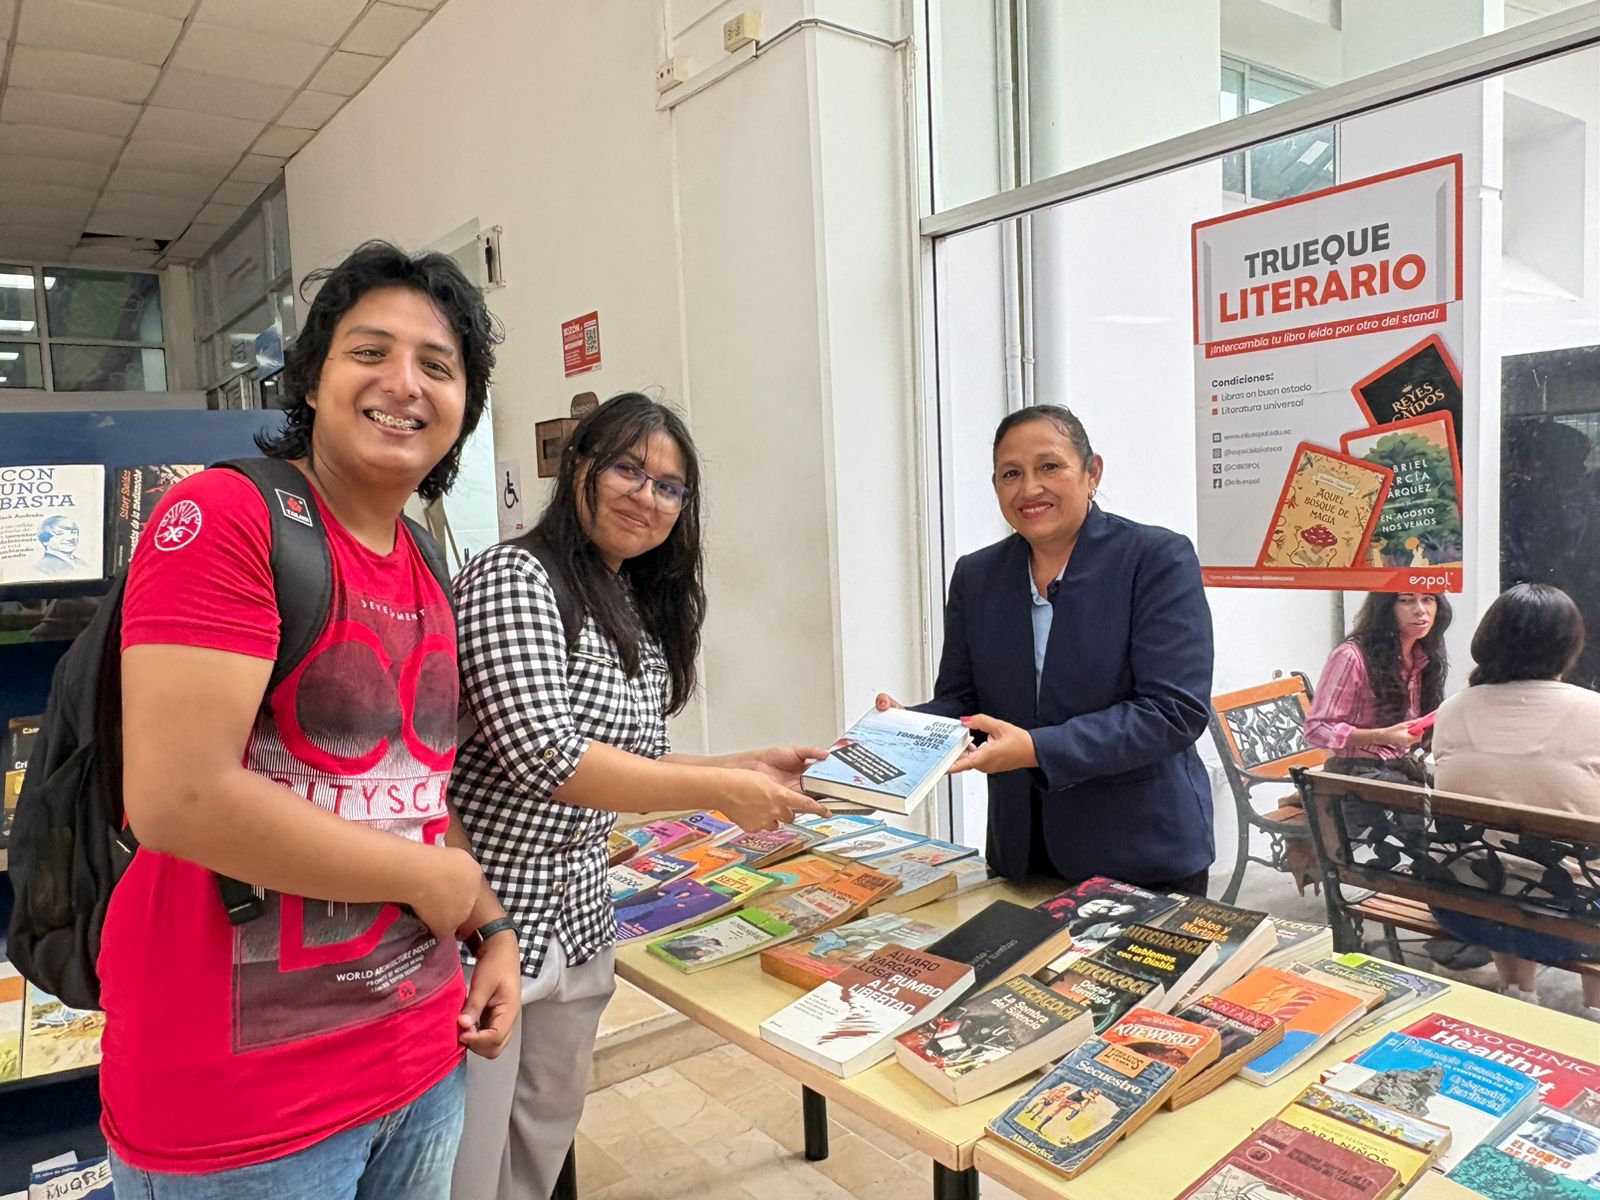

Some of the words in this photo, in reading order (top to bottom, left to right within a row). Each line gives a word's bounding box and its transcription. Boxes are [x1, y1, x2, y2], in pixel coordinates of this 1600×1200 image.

[1244, 223, 1390, 279] TRUEQUE
[1219, 253, 1426, 324] LITERARIO
[1271, 335, 1281, 345] tu
[1283, 331, 1306, 343] libro
[1335, 324, 1354, 337] por
[1356, 319, 1379, 331] otro
[1381, 315, 1400, 327] del
[1401, 309, 1440, 324] stand!
[1212, 373, 1274, 388] Condiciones:
[1391, 382, 1434, 412] REYES
[1, 468, 55, 482] CON
[0, 481, 54, 496] UNO
[0, 494, 75, 510] BASTA
[1409, 571, 1451, 589] espol
[896, 731, 945, 745] TORMENTA
[1192, 916, 1222, 932] Velos
[1127, 944, 1177, 962] Hablemos
[1142, 956, 1175, 971] Diablo
[336, 970, 373, 982] WORLD
[868, 955, 921, 978] VARGAS
[866, 979, 882, 989] A
[879, 983, 900, 997] LA
[888, 974, 945, 998] RUMBO
[1070, 984, 1111, 1005] Verdugo
[848, 983, 916, 1014] LIBERTAD
[1002, 993, 1016, 1004] La
[1015, 1001, 1049, 1023] Sombra
[1006, 977, 1082, 1020] HITCHCOCK
[991, 998, 1010, 1009] del
[1006, 1006, 1041, 1030] Silencio
[1113, 1023, 1202, 1046] KITEWORLD
[1429, 1030, 1554, 1079] Healthy
[1435, 1019, 1504, 1045] MAYO
[1505, 1043, 1597, 1076] CLINIC
[1076, 1060, 1142, 1094] Secuestro
[1510, 1139, 1526, 1150] EL
[1526, 1146, 1572, 1169] COSTO
